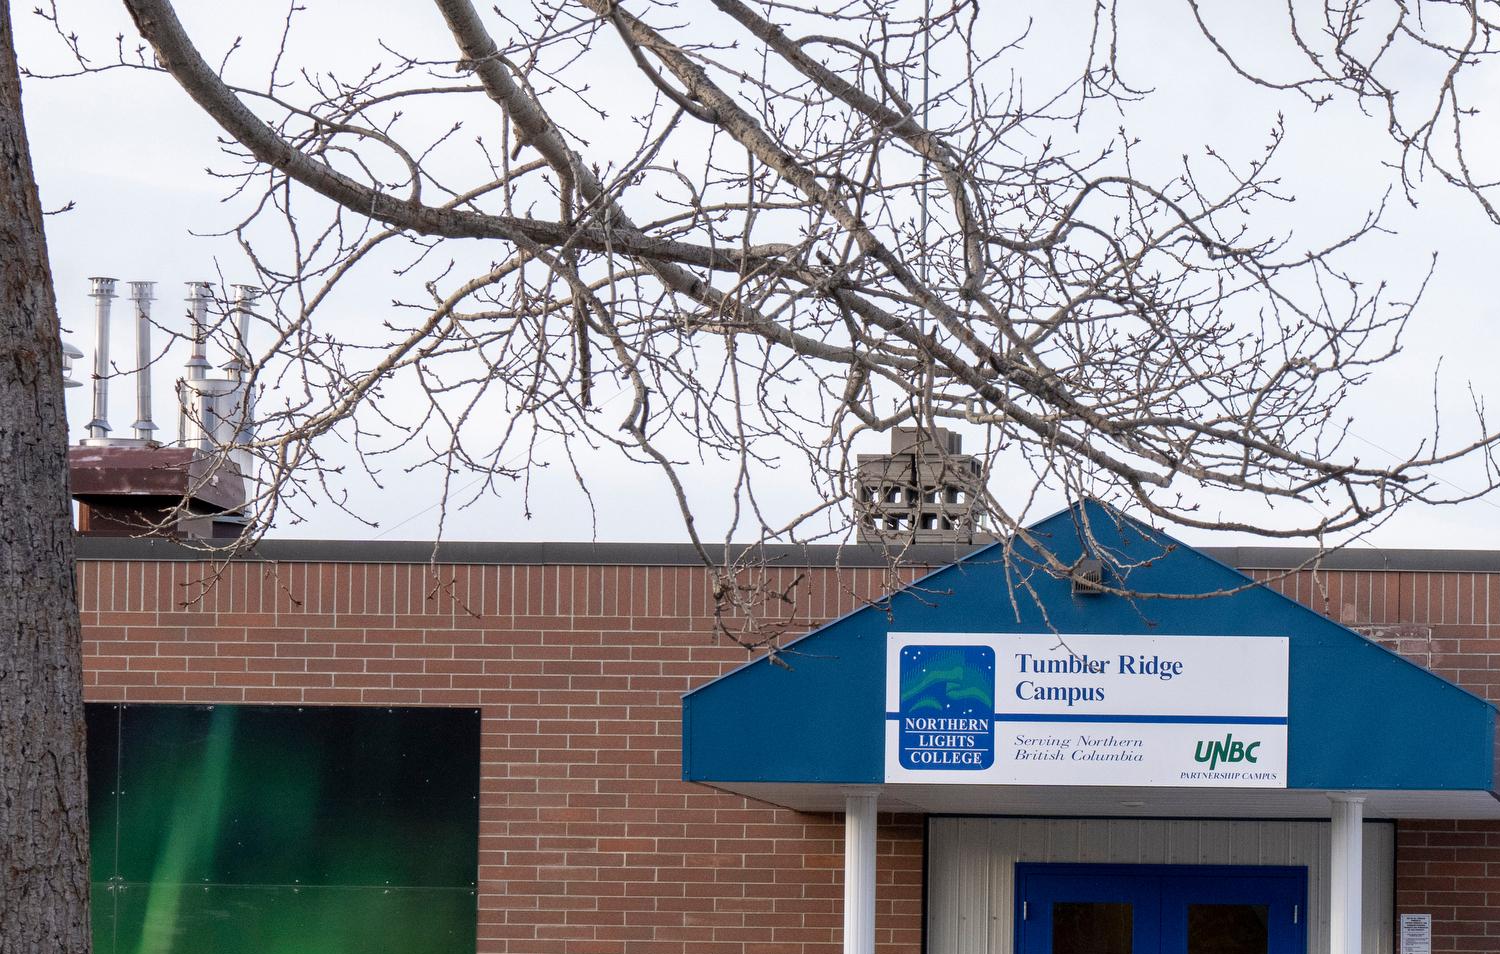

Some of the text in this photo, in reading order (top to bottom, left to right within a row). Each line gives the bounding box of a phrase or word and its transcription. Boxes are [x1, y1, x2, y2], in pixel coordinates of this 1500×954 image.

[1015, 653, 1184, 681] Tumbler Ridge
[1015, 680, 1105, 707] Campus
[905, 717, 989, 731] NORTHERN
[919, 735, 975, 748] LIGHTS
[1014, 734, 1144, 749] Serving Northern
[910, 751, 982, 764] COLLEGE
[1014, 749, 1144, 762] British Columbia
[1194, 733, 1261, 770] UNBC
[1180, 771, 1278, 781] PARTNERSHIP CAMPUS
